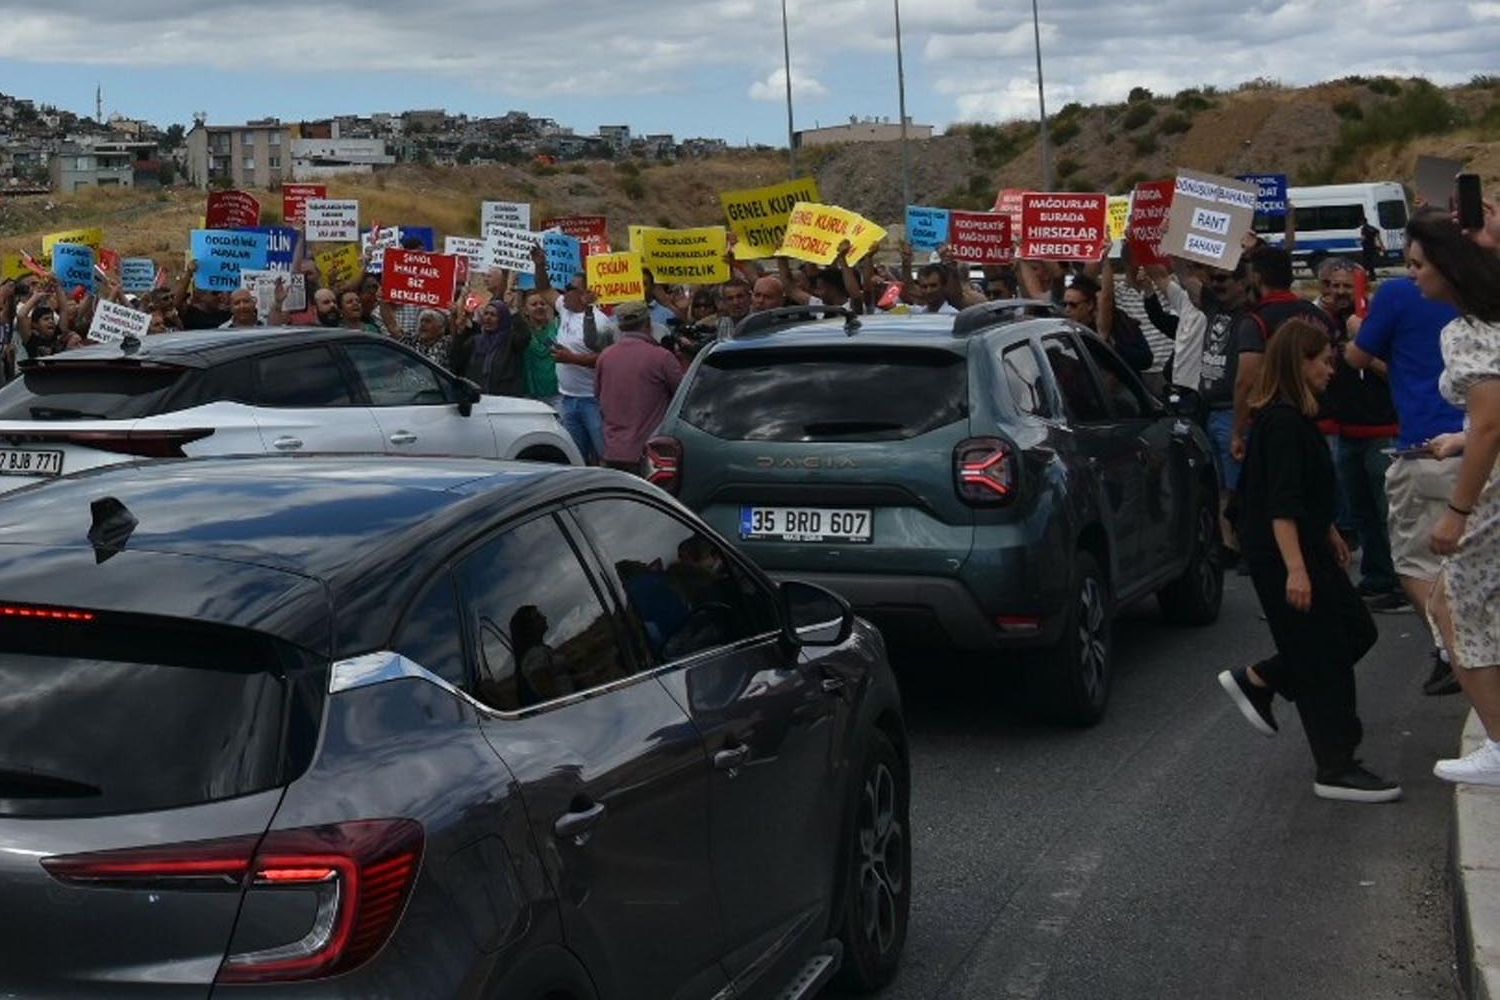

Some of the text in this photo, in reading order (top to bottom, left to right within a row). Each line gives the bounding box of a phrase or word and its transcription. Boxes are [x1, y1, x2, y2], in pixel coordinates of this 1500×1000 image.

[1028, 197, 1099, 209] MAĞDURLAR
[727, 201, 767, 221] GENEL
[1040, 212, 1085, 222] BURADA
[815, 213, 849, 236] KURUL
[1198, 212, 1226, 229] RANT
[745, 223, 787, 247] İSTİYO
[1028, 226, 1097, 240] HIRSIZLAR
[986, 244, 1011, 259] AİLE
[1028, 243, 1094, 257] NEREDE ?
[220, 261, 241, 273] PUL
[657, 264, 715, 277] HIRSIZLIK
[36, 453, 58, 471] 771
[755, 456, 860, 470] DACIA
[752, 511, 867, 534] 35 BRD 607
